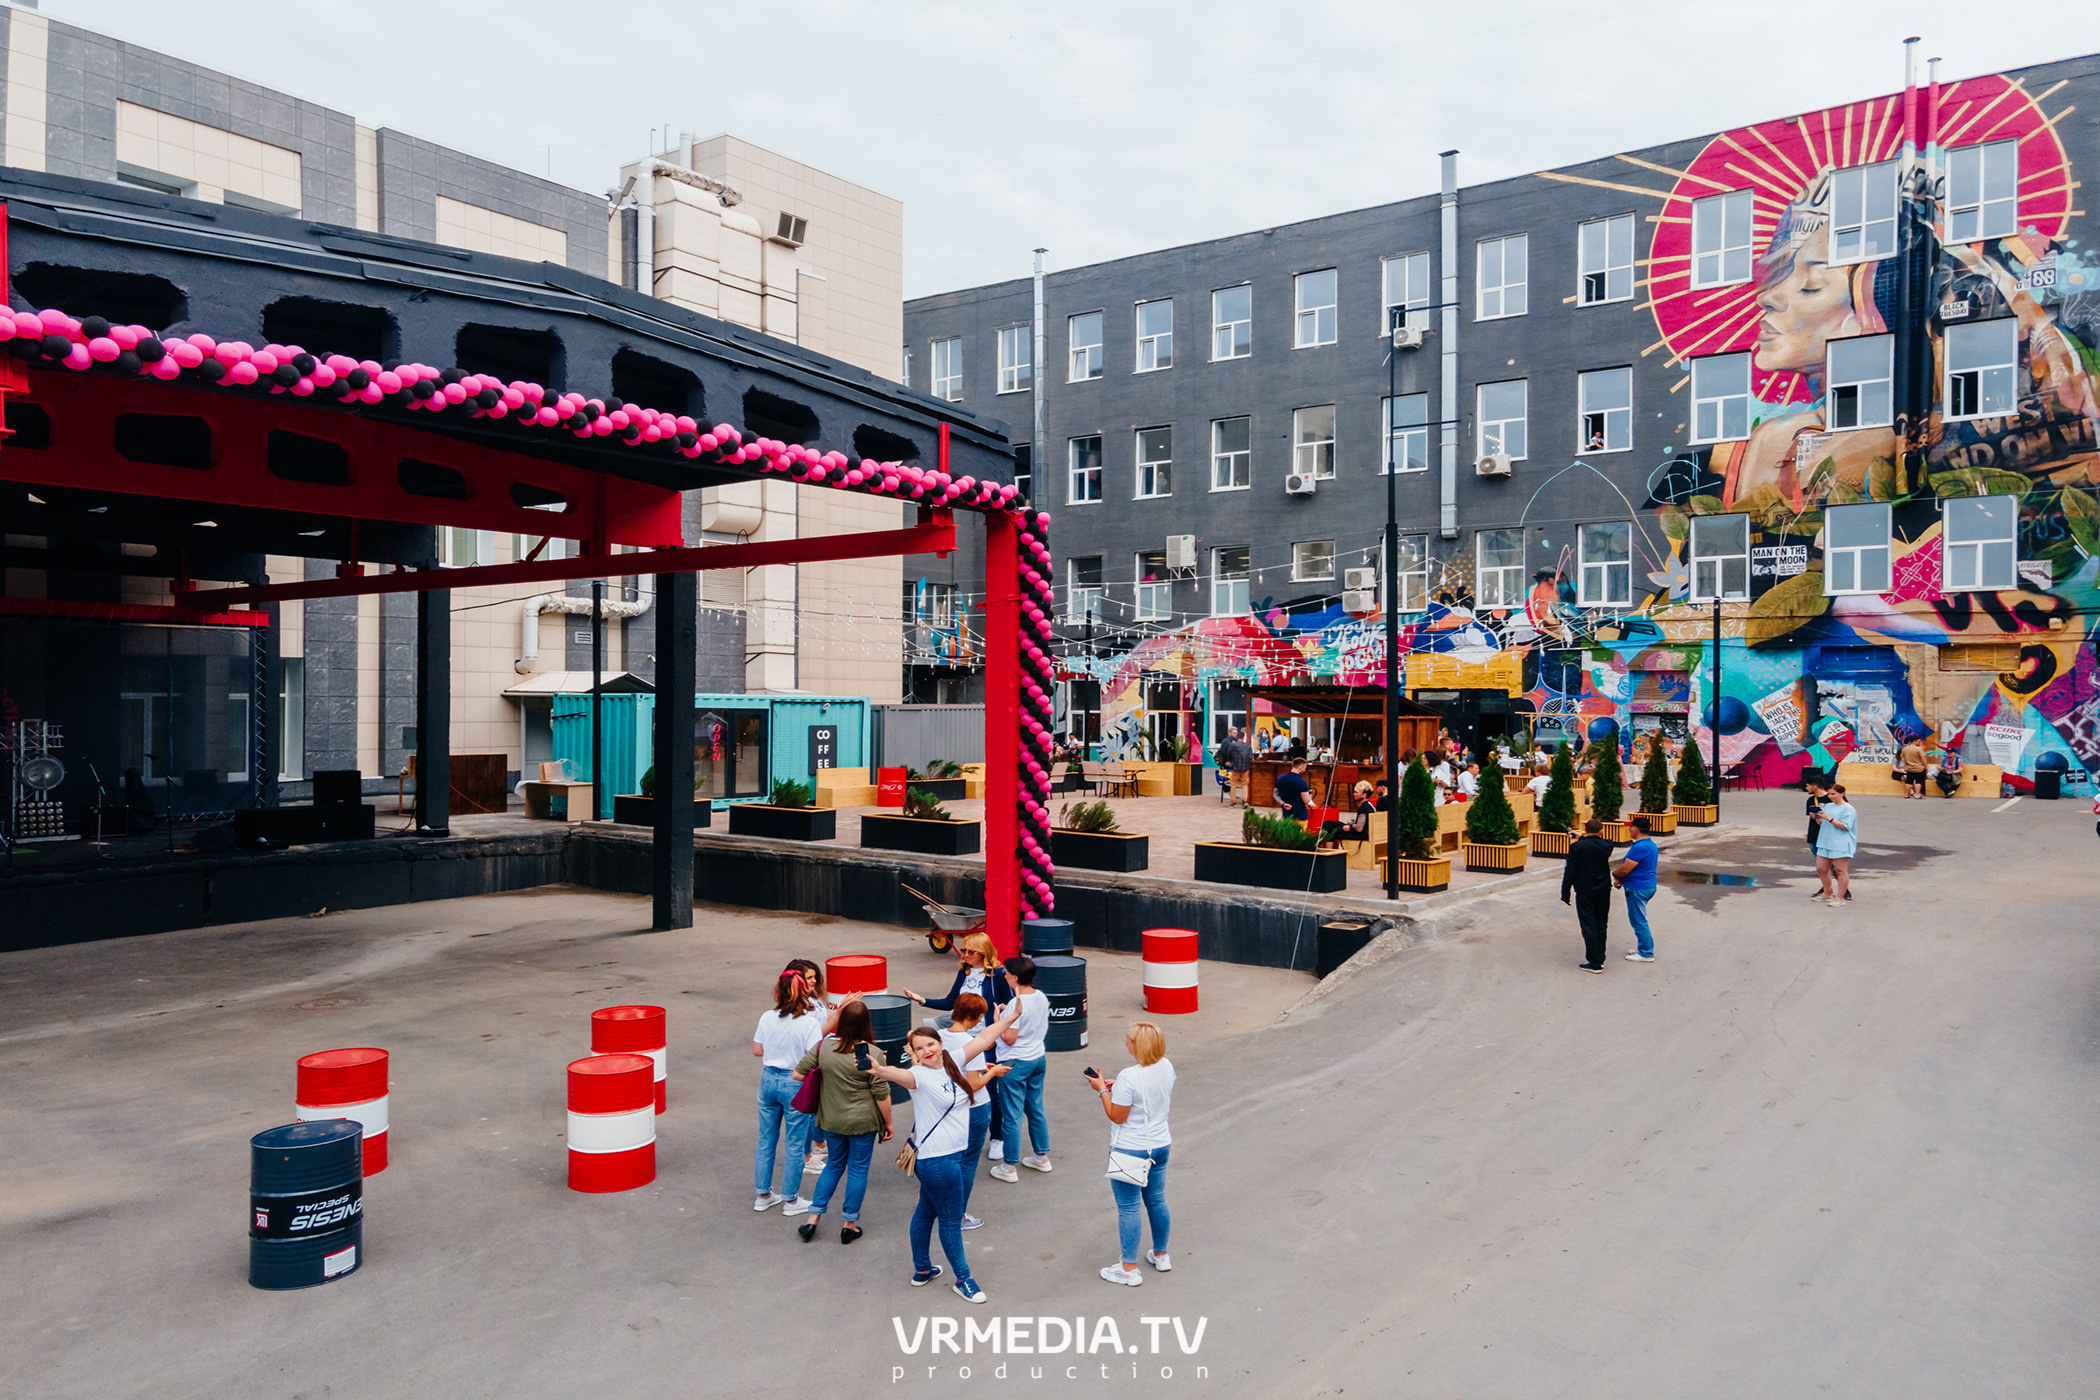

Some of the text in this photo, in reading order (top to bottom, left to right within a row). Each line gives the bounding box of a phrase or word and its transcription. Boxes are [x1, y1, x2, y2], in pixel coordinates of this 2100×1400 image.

[1753, 546, 1806, 558] MAN ON THE
[1780, 555, 1806, 565] MOON
[1763, 703, 1791, 721] WHO IS
[713, 724, 721, 761] OPEN
[1858, 755, 1874, 763] YOU
[296, 1194, 350, 1213] SPECIAL
